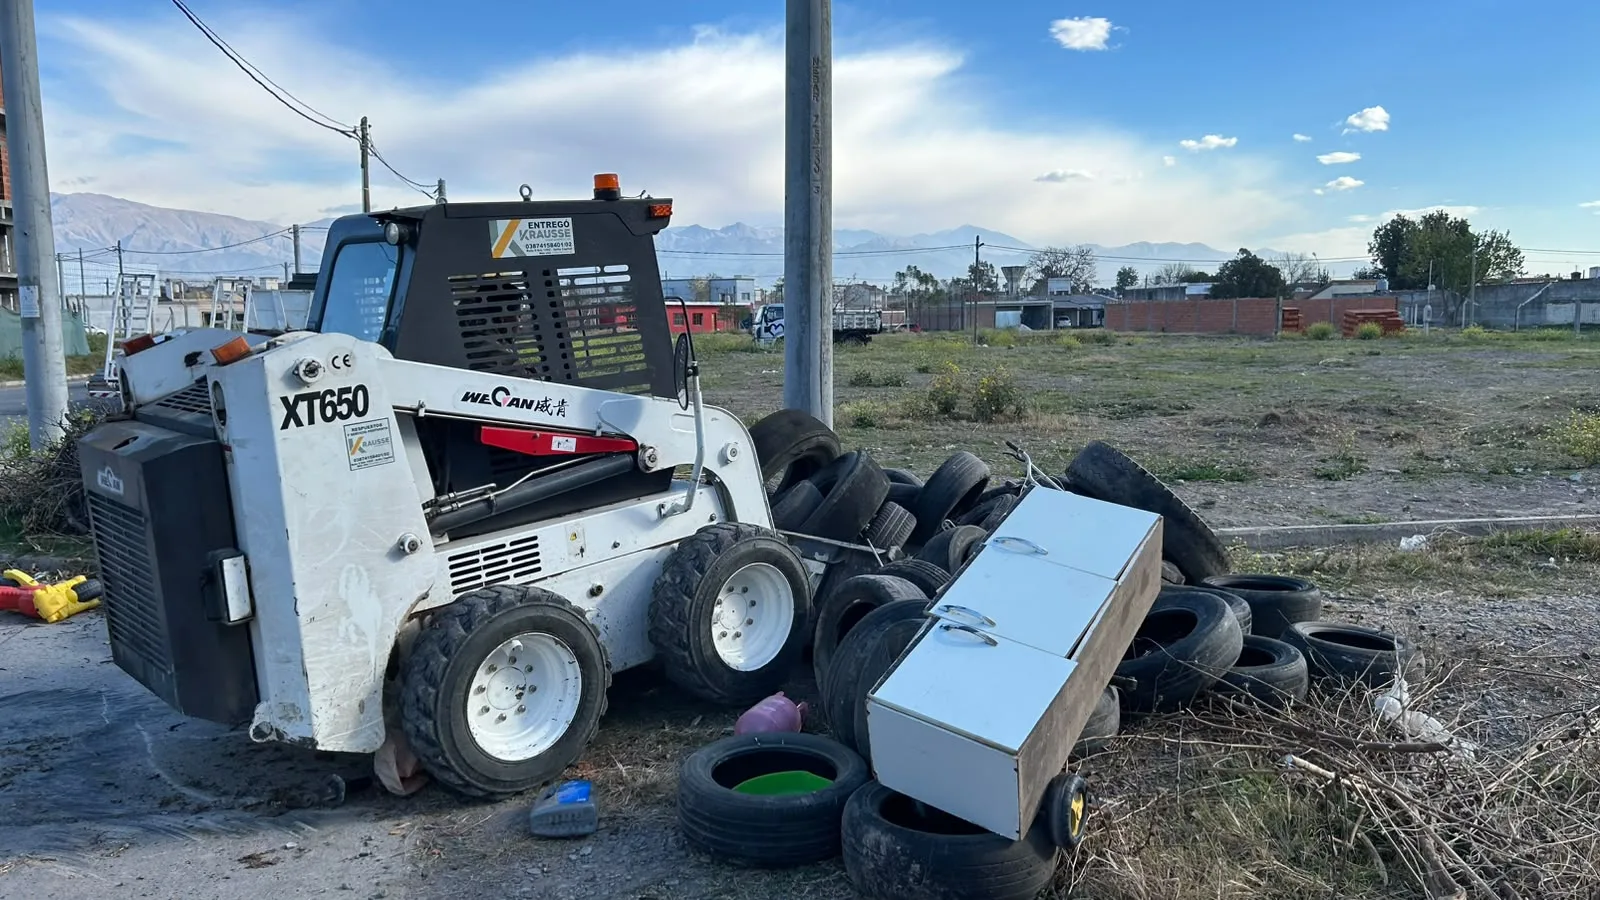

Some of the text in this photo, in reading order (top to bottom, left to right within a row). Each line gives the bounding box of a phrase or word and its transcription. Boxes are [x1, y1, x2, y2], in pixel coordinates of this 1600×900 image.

[528, 219, 570, 229] ENTREGÓ
[519, 229, 571, 240] KRAUSSE
[331, 354, 351, 369] CE
[279, 384, 369, 430] XT650
[461, 386, 570, 417] WECAN 威肯
